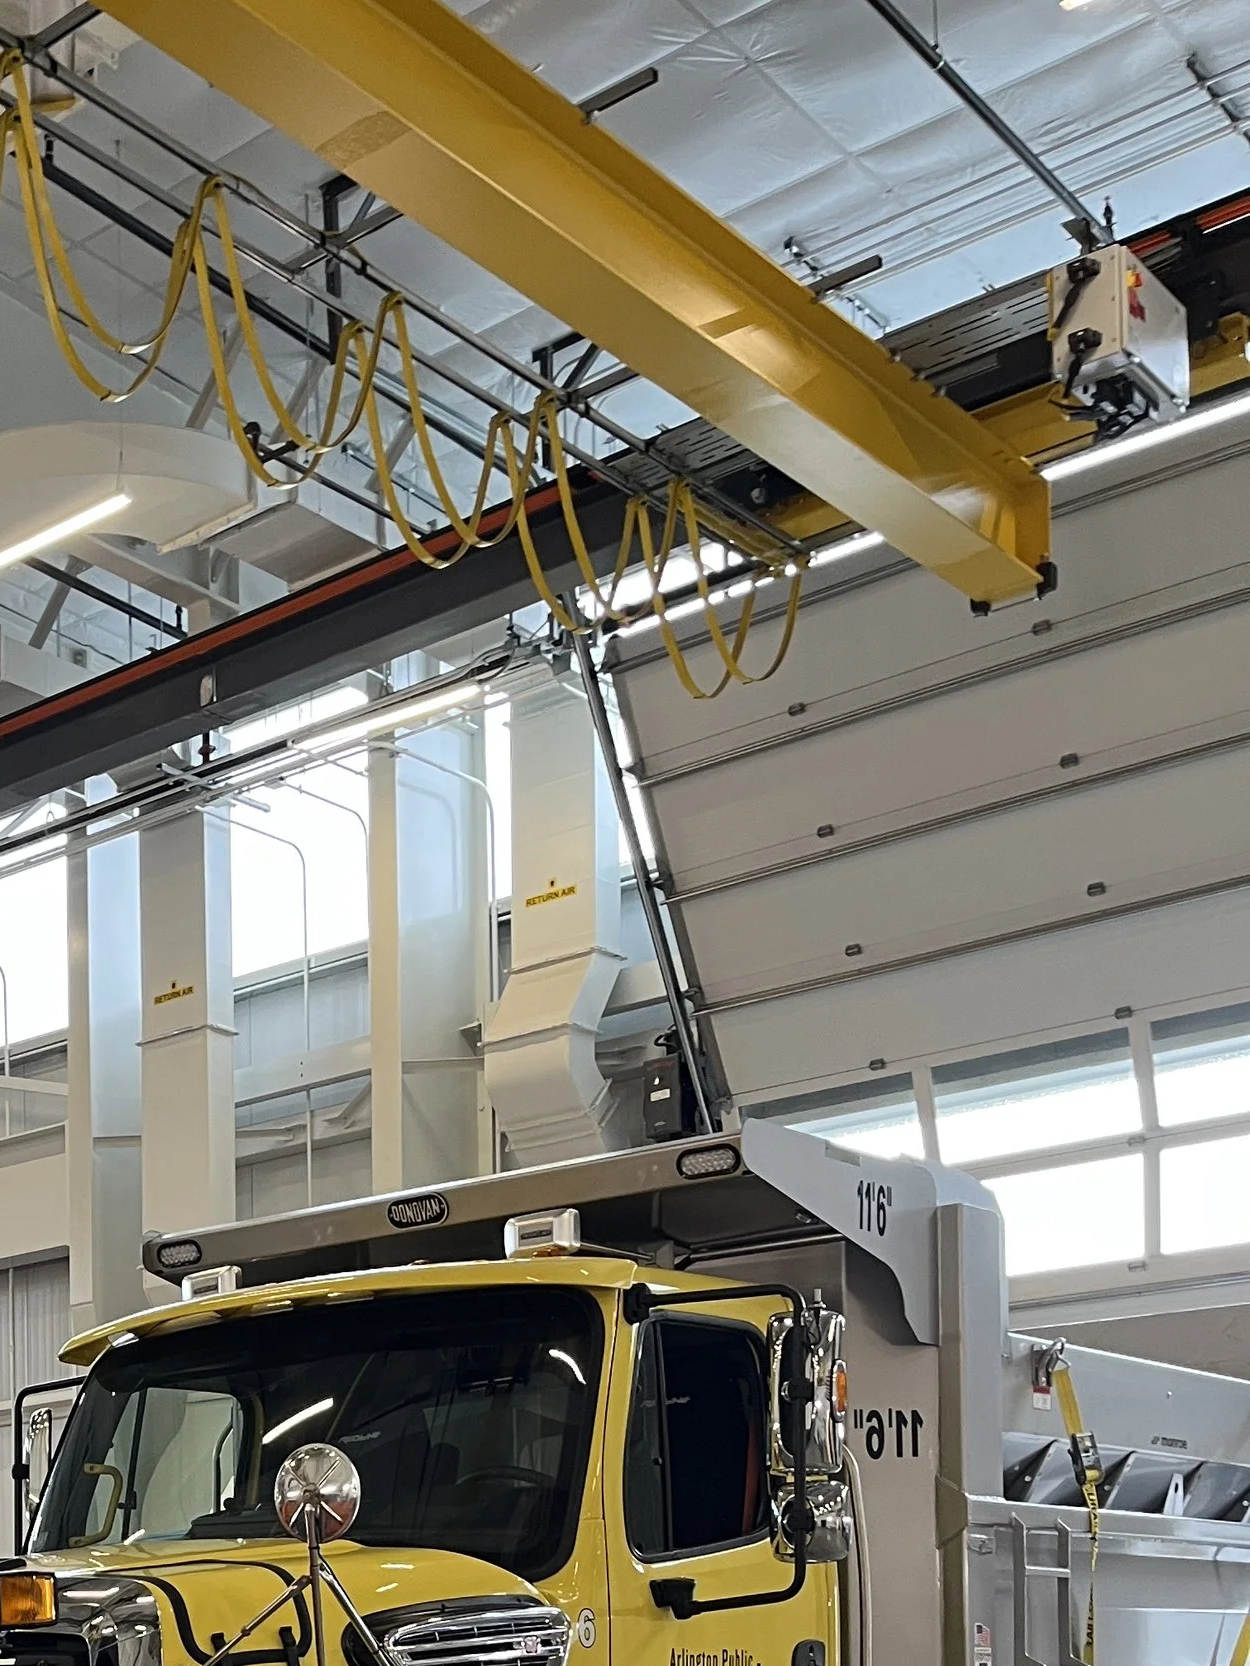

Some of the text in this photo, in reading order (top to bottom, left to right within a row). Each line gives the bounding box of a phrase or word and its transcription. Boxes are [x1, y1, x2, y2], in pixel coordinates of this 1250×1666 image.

[525, 886, 576, 907] RETURN AIR
[391, 1198, 440, 1223] DONOVAN
[857, 1180, 892, 1236] 11'6"
[578, 1608, 596, 1648] 6
